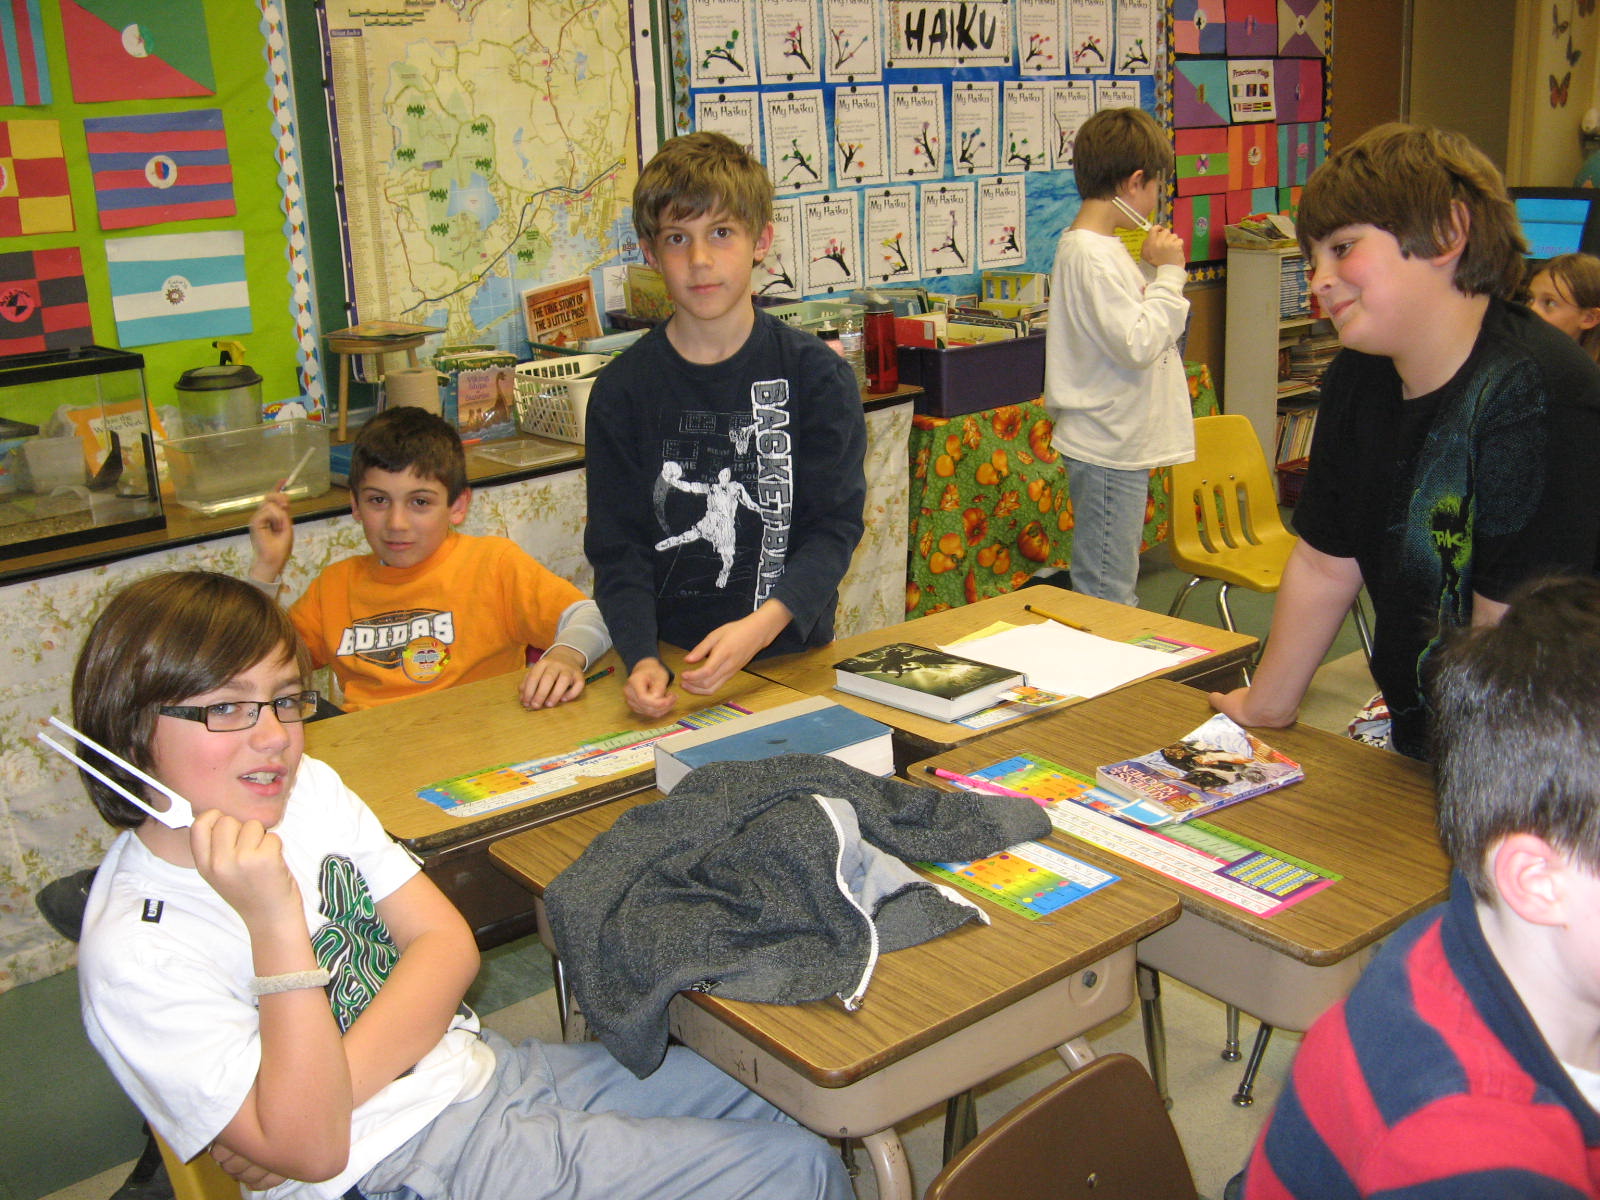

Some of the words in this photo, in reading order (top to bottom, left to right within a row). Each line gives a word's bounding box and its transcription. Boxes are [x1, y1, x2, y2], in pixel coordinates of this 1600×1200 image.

[904, 2, 996, 56] HAIKU
[703, 107, 718, 120] My
[720, 104, 748, 117] Haiku
[772, 105, 786, 118] My
[788, 102, 814, 115] Haiku
[809, 207, 821, 220] My
[823, 204, 849, 216] Haiku
[533, 308, 544, 319] THE
[558, 297, 576, 310] STORY
[576, 293, 584, 305] OF
[535, 320, 546, 332] THE
[552, 311, 571, 327] LITTLE
[750, 378, 793, 612] BASKETBAL
[336, 611, 455, 656] ADIDAS
